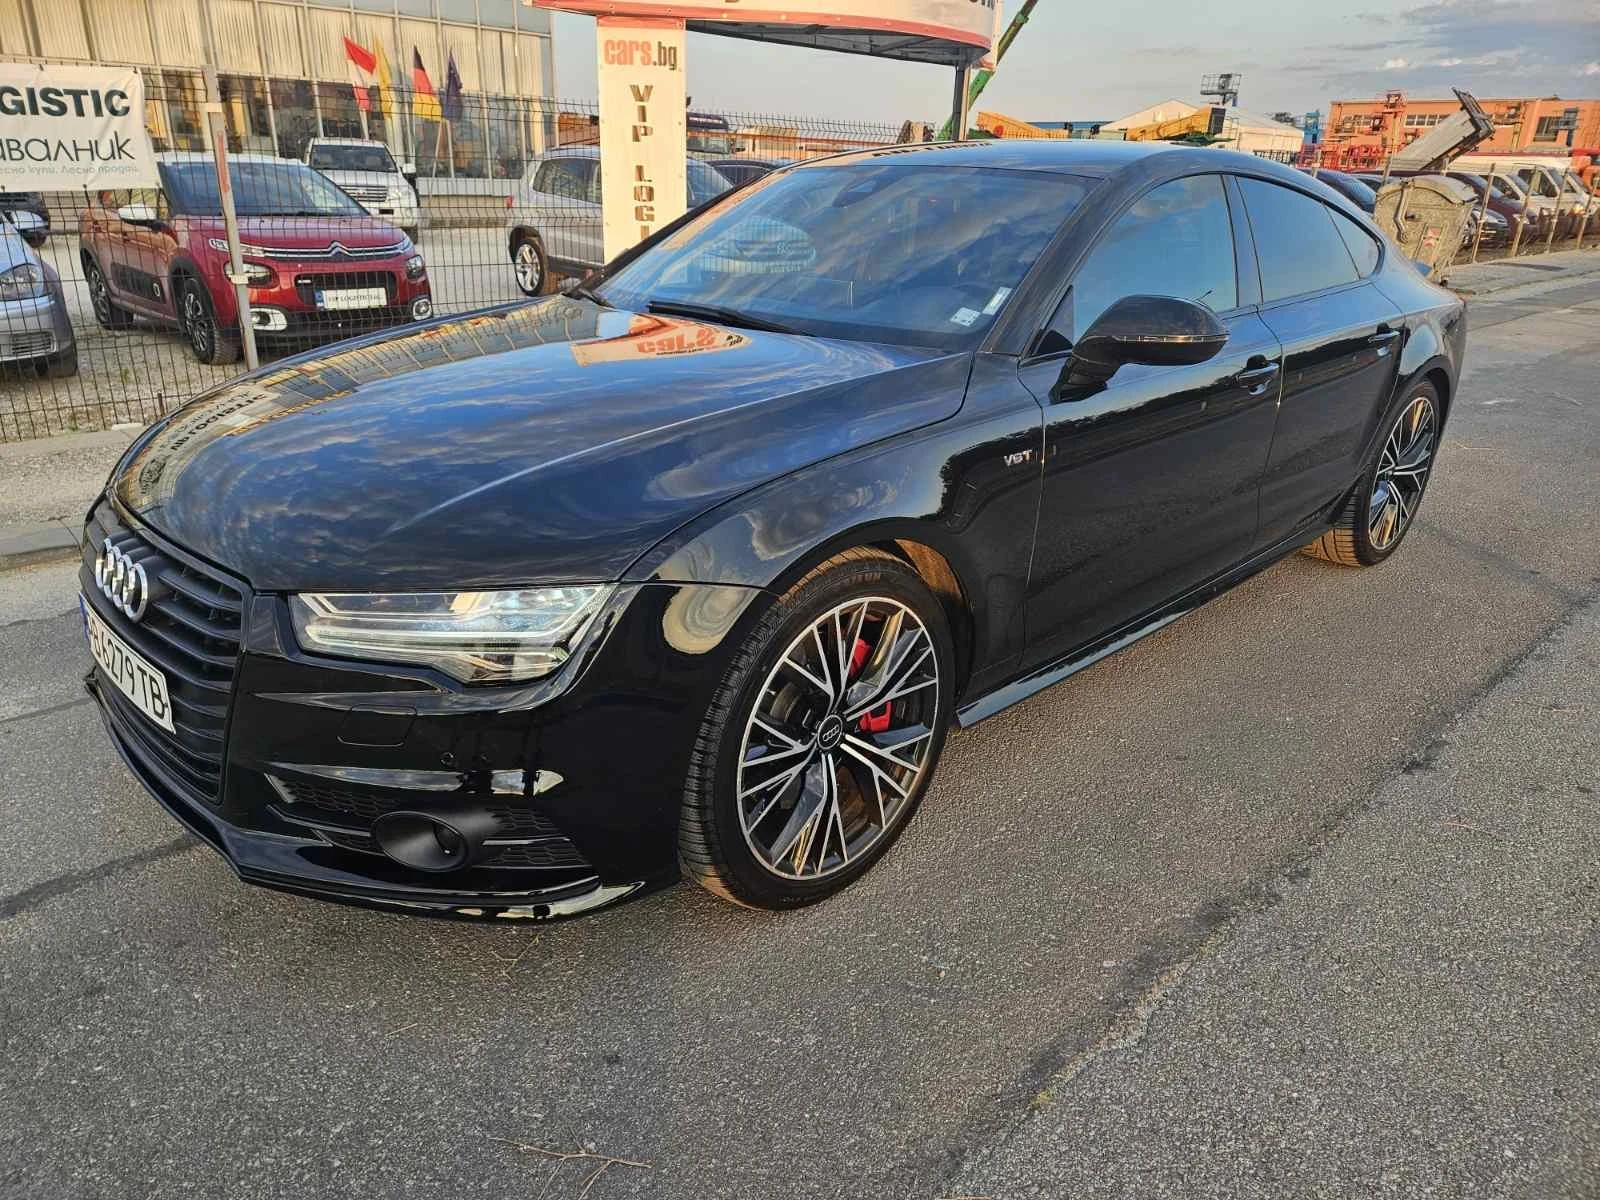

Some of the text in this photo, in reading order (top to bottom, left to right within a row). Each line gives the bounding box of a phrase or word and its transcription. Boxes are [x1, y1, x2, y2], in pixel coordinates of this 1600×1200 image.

[603, 40, 677, 71] cars.bg
[0, 85, 130, 118] GISTIC
[630, 84, 654, 142] VIP
